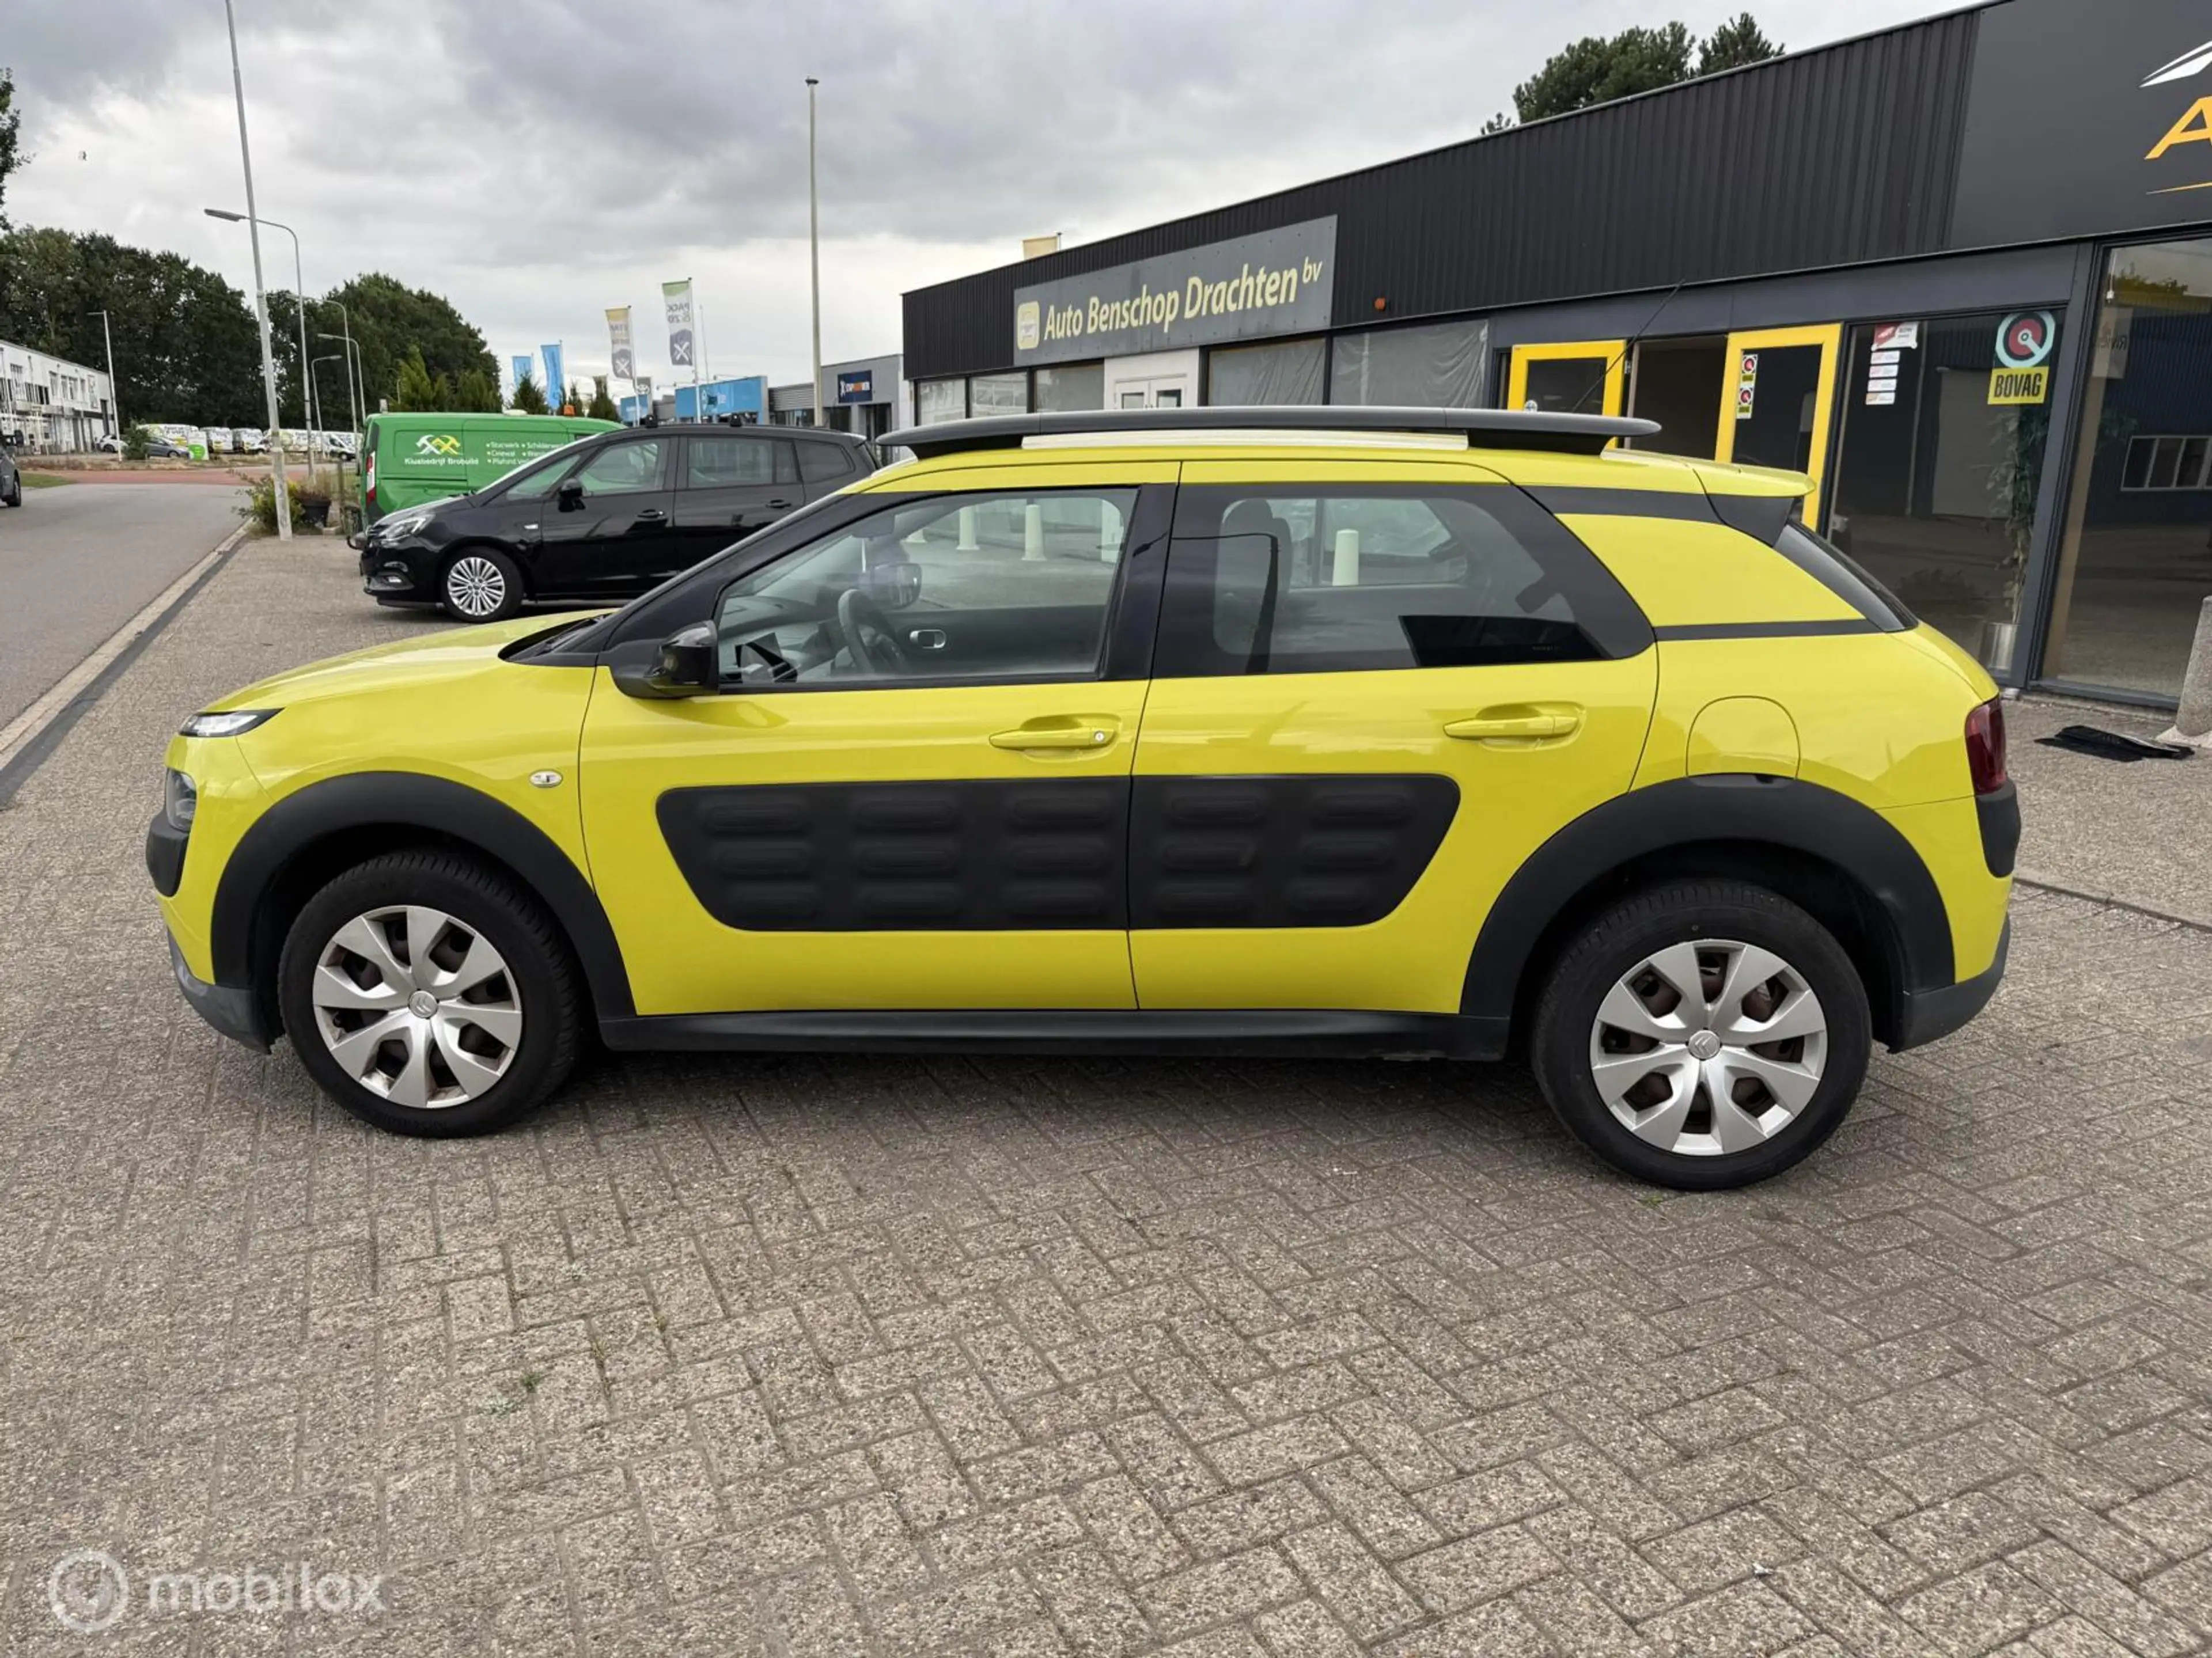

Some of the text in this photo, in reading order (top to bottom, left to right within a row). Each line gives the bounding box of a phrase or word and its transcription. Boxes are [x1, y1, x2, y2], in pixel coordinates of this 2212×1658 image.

[1044, 257, 1323, 340] Auto Benschop Drachten bv
[1994, 373, 2042, 397] BOVAG
